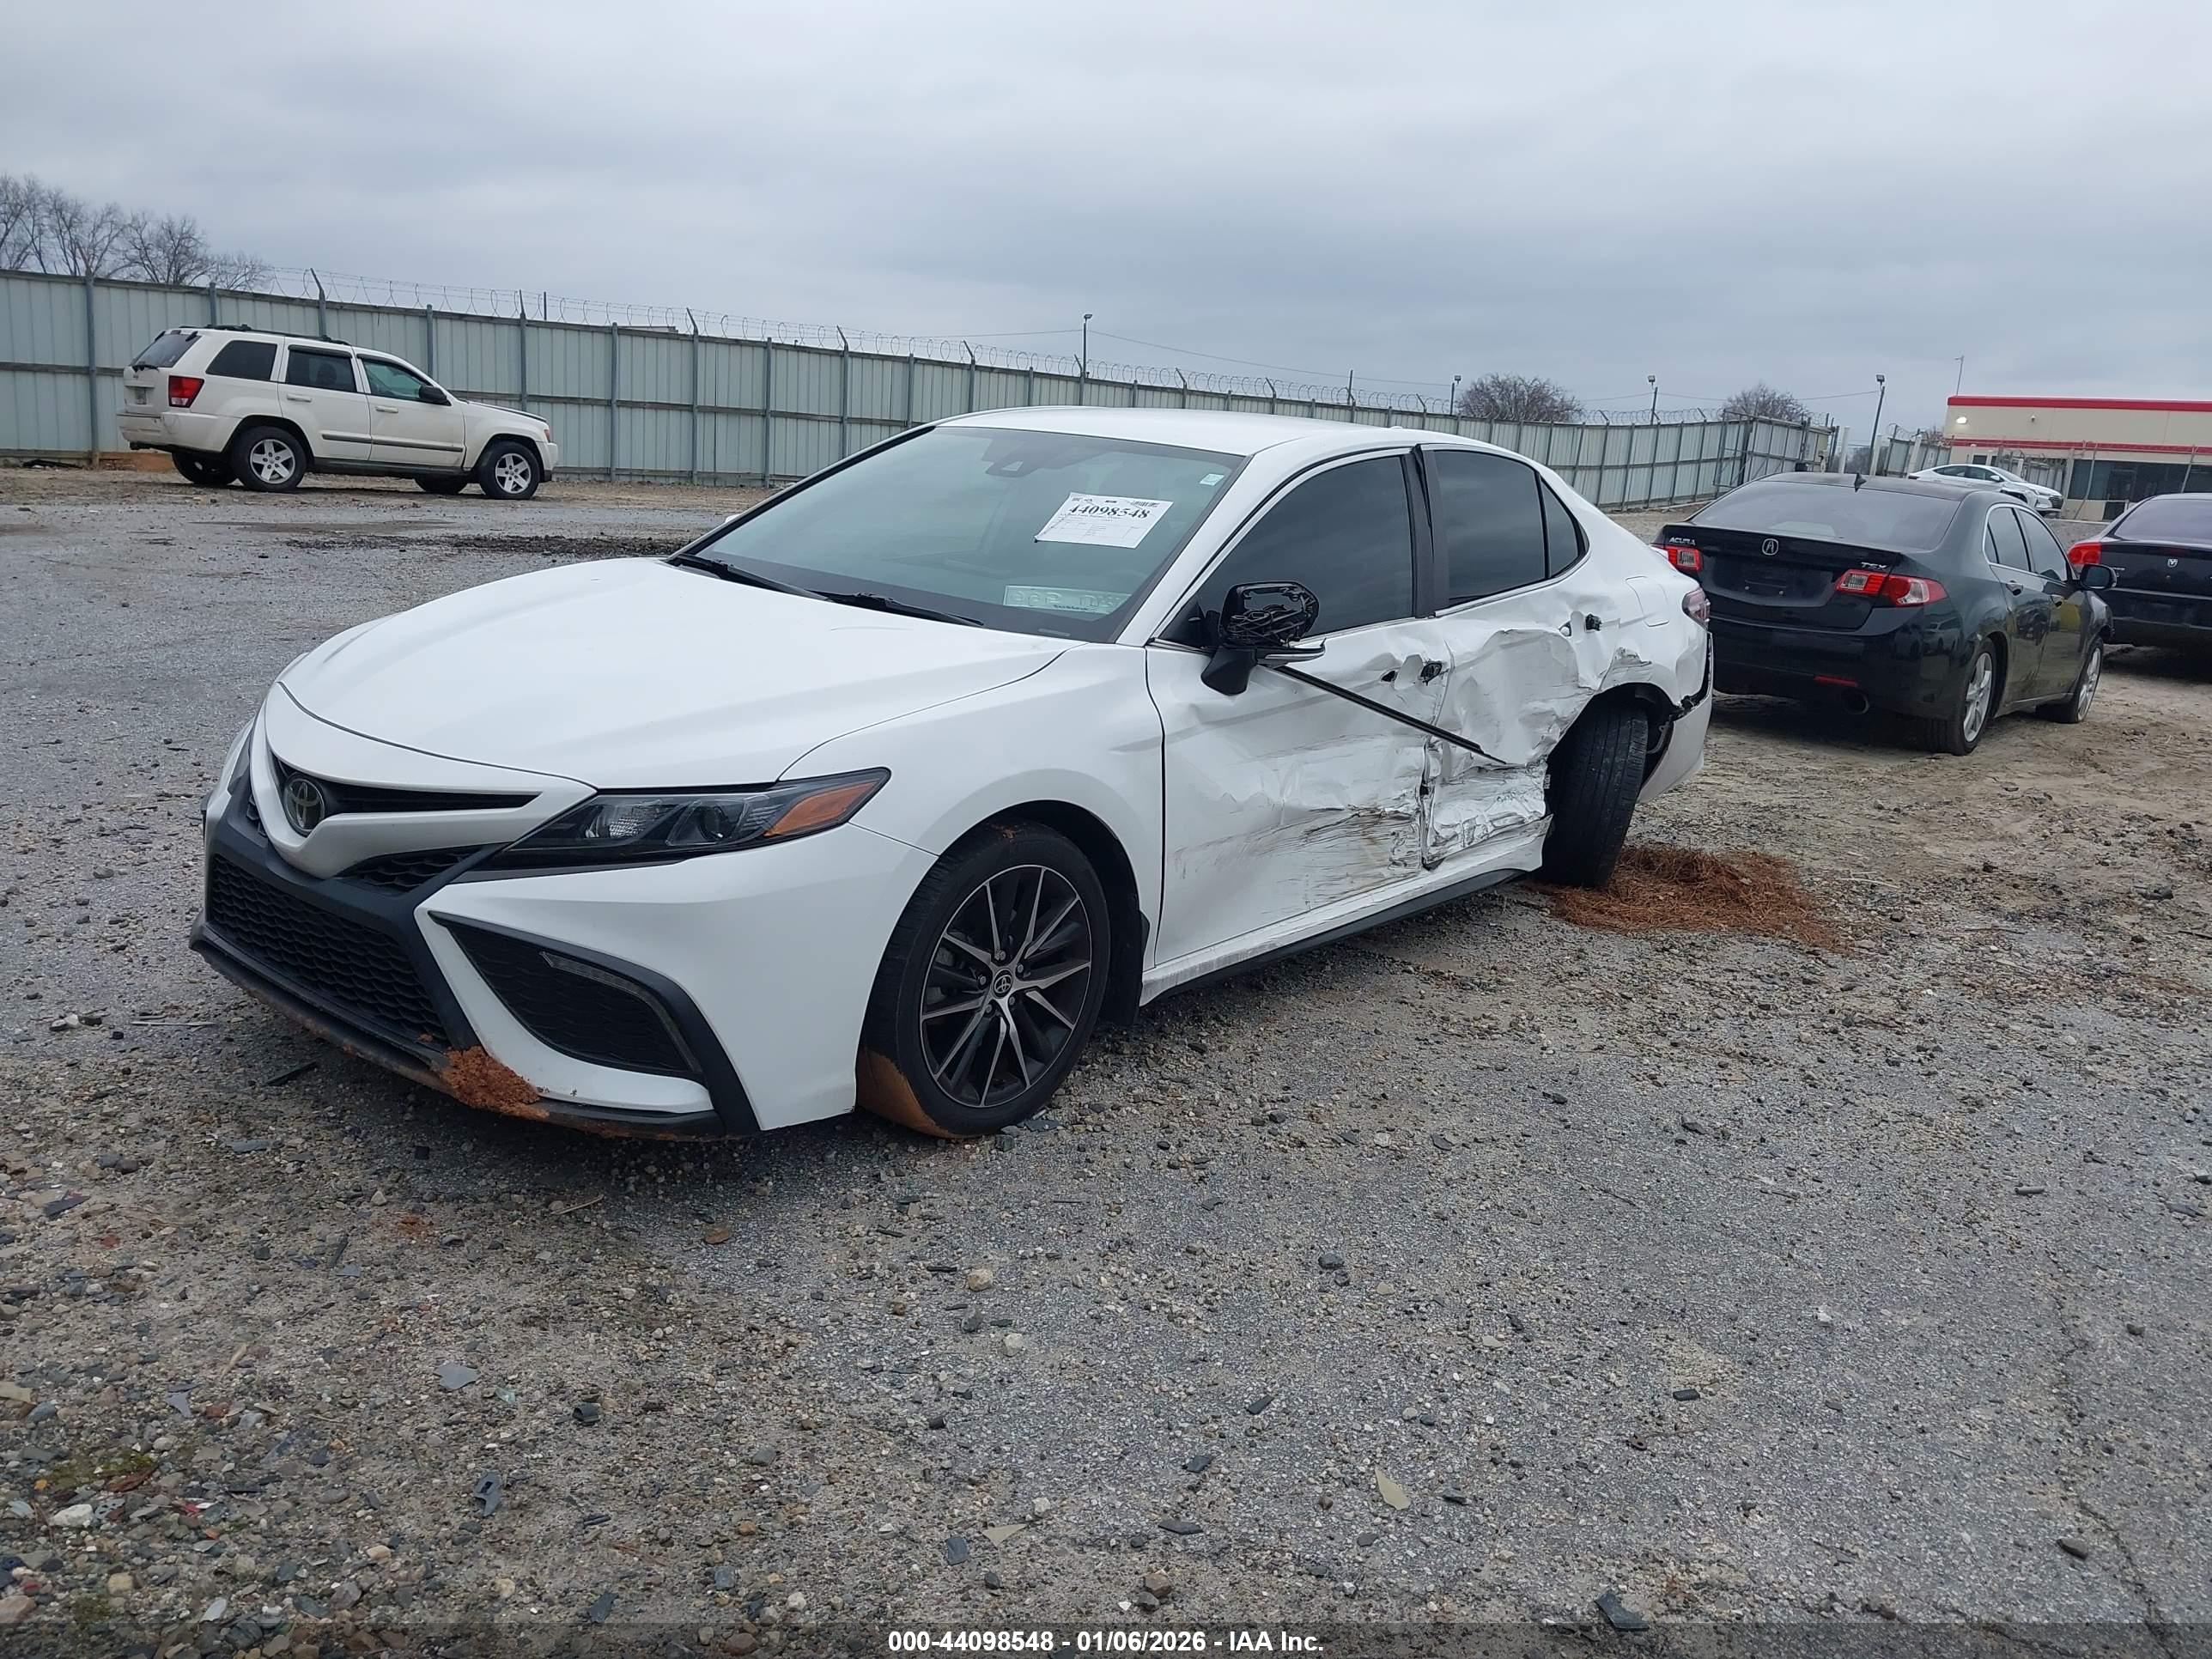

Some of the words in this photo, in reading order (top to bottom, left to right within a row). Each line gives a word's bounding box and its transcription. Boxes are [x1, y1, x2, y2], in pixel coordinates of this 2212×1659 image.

[1069, 504, 1151, 519] 44098548
[1668, 537, 1696, 546] ACURA
[1861, 562, 1887, 571] TSX
